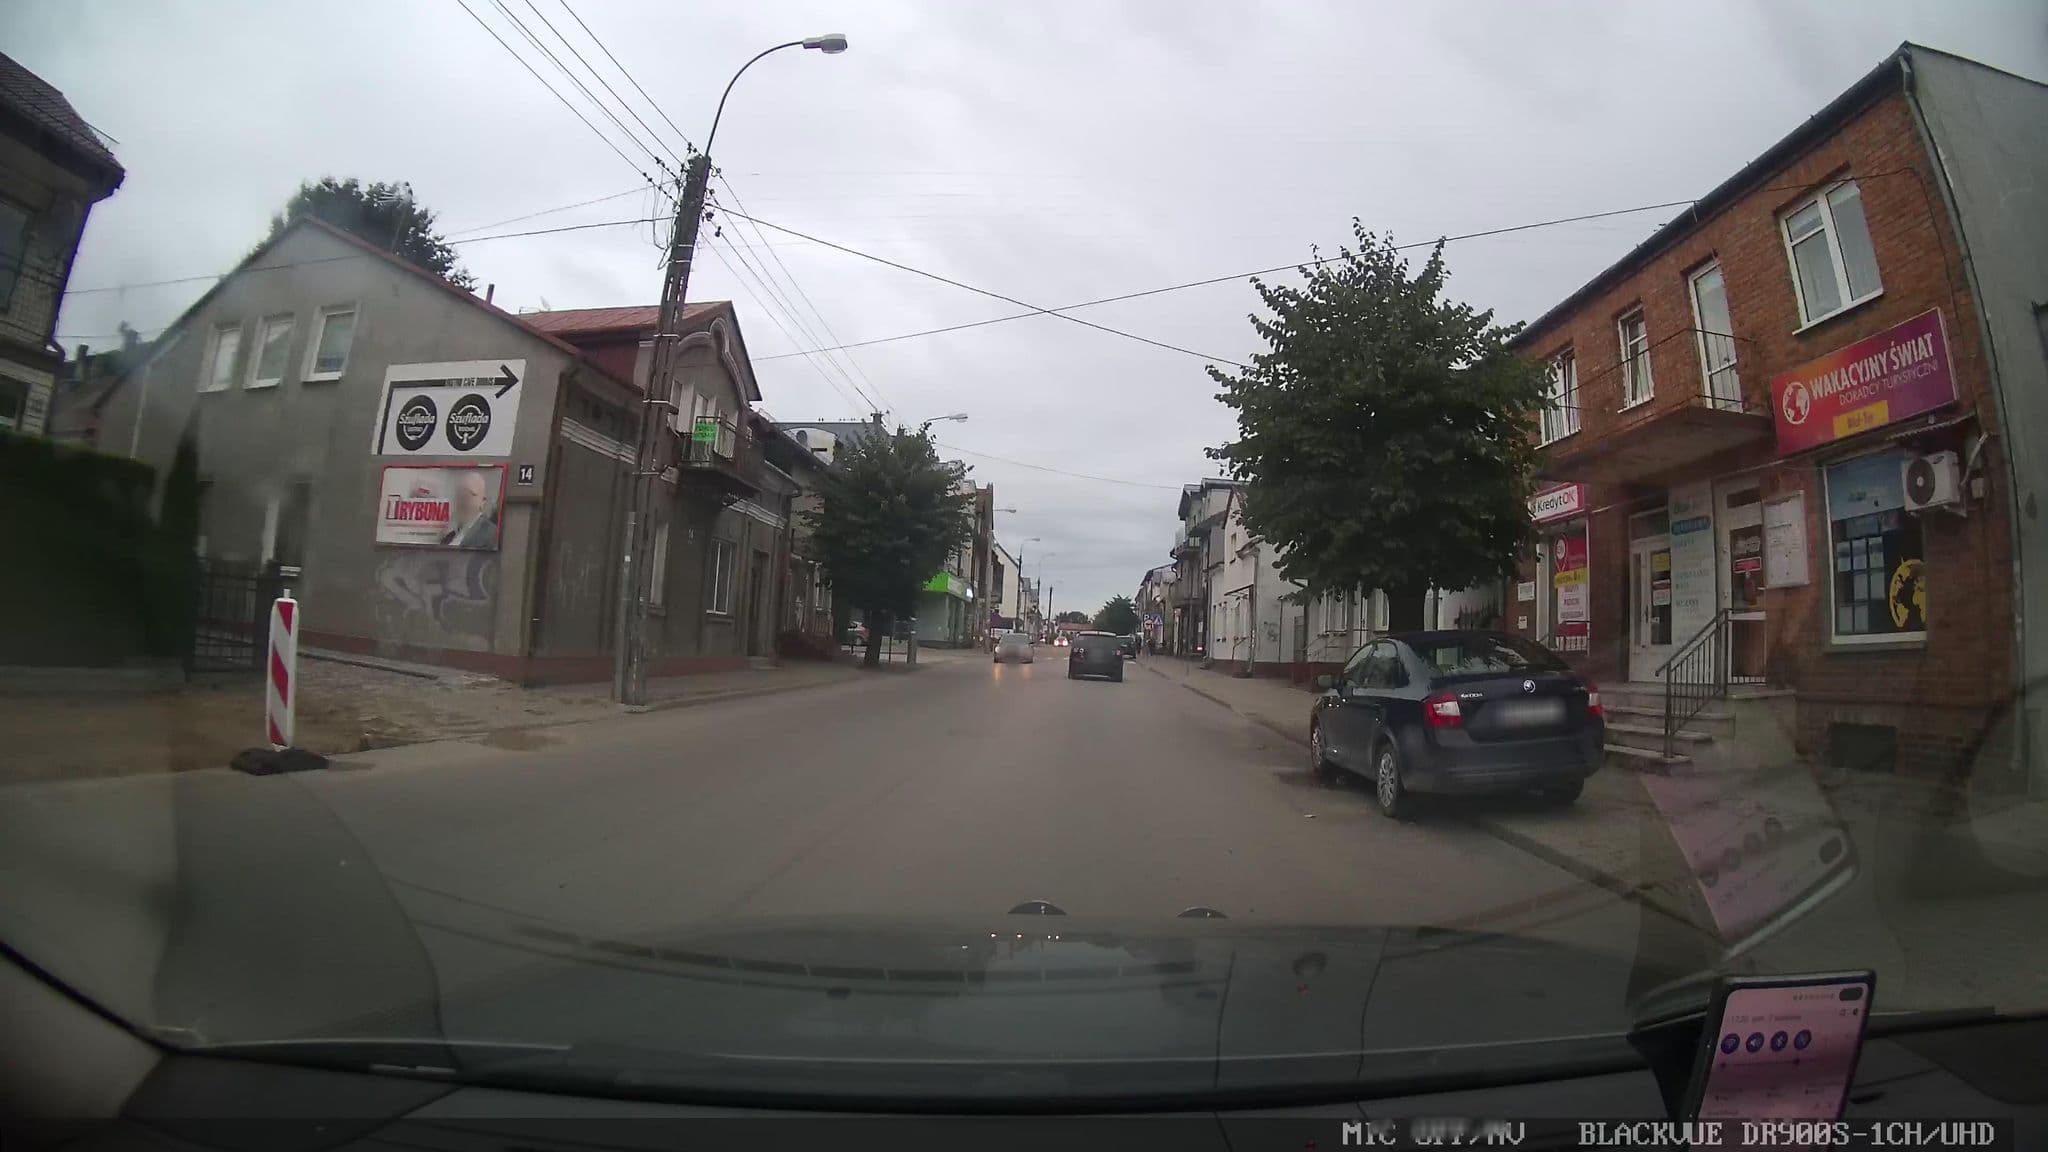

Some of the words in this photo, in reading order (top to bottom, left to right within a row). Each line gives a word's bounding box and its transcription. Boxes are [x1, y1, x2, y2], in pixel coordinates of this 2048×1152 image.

[1809, 350, 1888, 401] WAKACYJNY
[1889, 332, 1934, 371] ŚWIAT
[448, 411, 490, 426] Szuflada
[520, 467, 533, 482] 14
